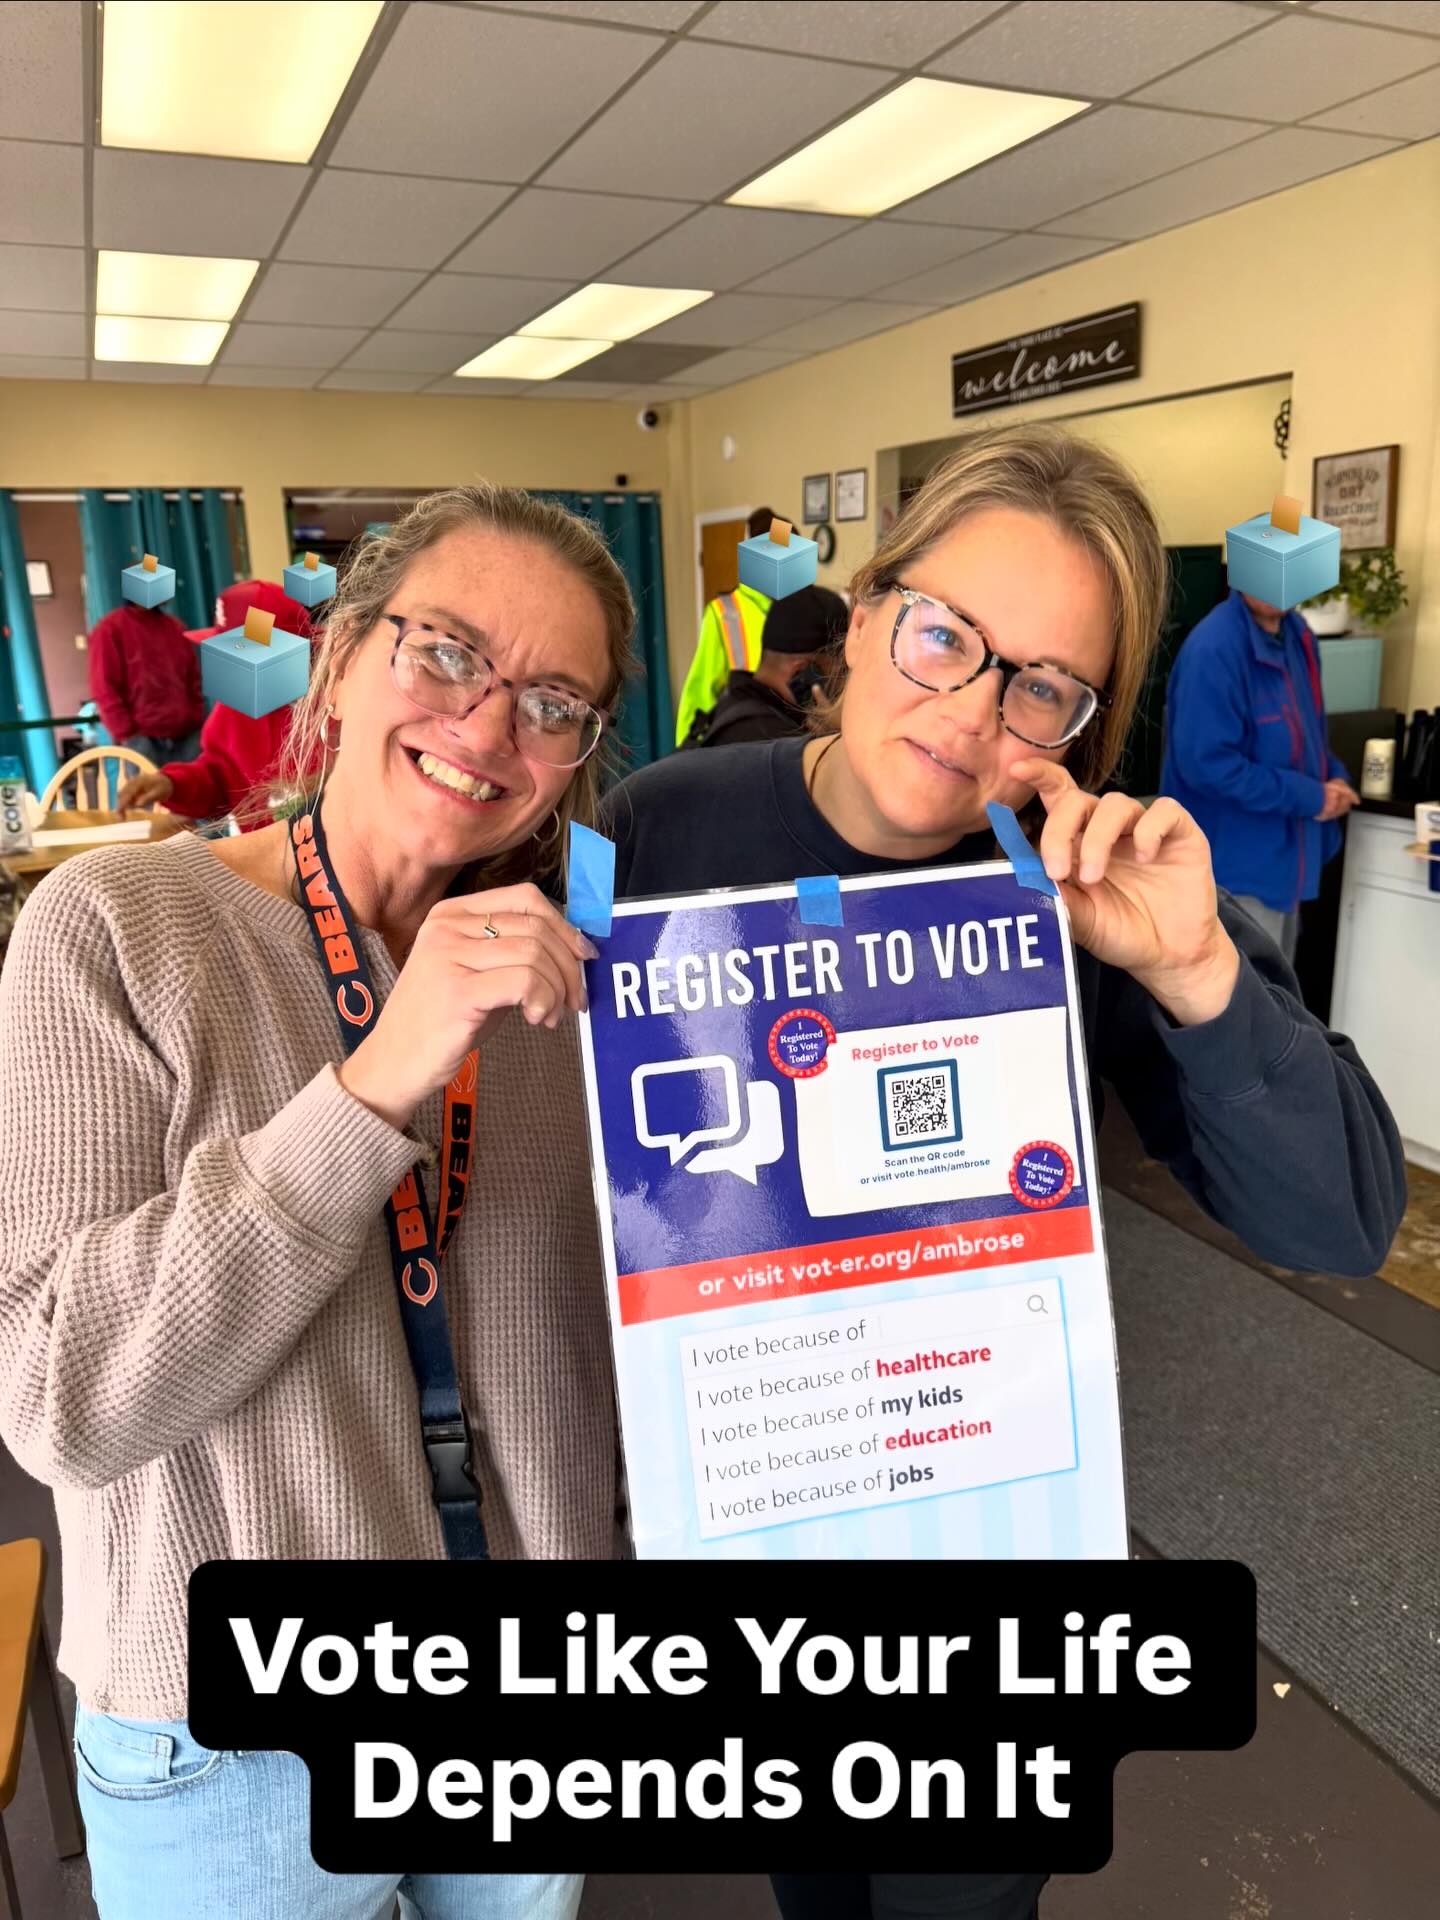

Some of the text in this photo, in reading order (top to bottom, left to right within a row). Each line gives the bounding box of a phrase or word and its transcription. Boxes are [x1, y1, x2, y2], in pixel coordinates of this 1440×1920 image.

[958, 340, 1127, 399] welcome
[2, 786, 22, 833] core
[292, 814, 360, 975] BEARS
[611, 913, 1044, 1019] REGISTER TO VOTE
[780, 1029, 823, 1044] Registered
[798, 1021, 803, 1031] I
[787, 1042, 819, 1053] To Vote
[790, 1052, 818, 1064] Today!
[852, 1034, 979, 1061] Register to Vote
[860, 1158, 991, 1185] or visit vote.health/ambrose
[885, 1149, 966, 1167] Scan the QR code
[1022, 1158, 1064, 1176] Registered
[1024, 1180, 1052, 1195] Today!
[1026, 1170, 1056, 1185] To Vote
[698, 1232, 1025, 1296] or visit vot-er.org/ambrose
[692, 1319, 866, 1367] I vote because of
[697, 1347, 992, 1409] I vote because of healthcare
[701, 1385, 963, 1446] I vote because of my kids
[705, 1420, 992, 1482] I vote because of education
[710, 1465, 934, 1520] I vote because of jobs
